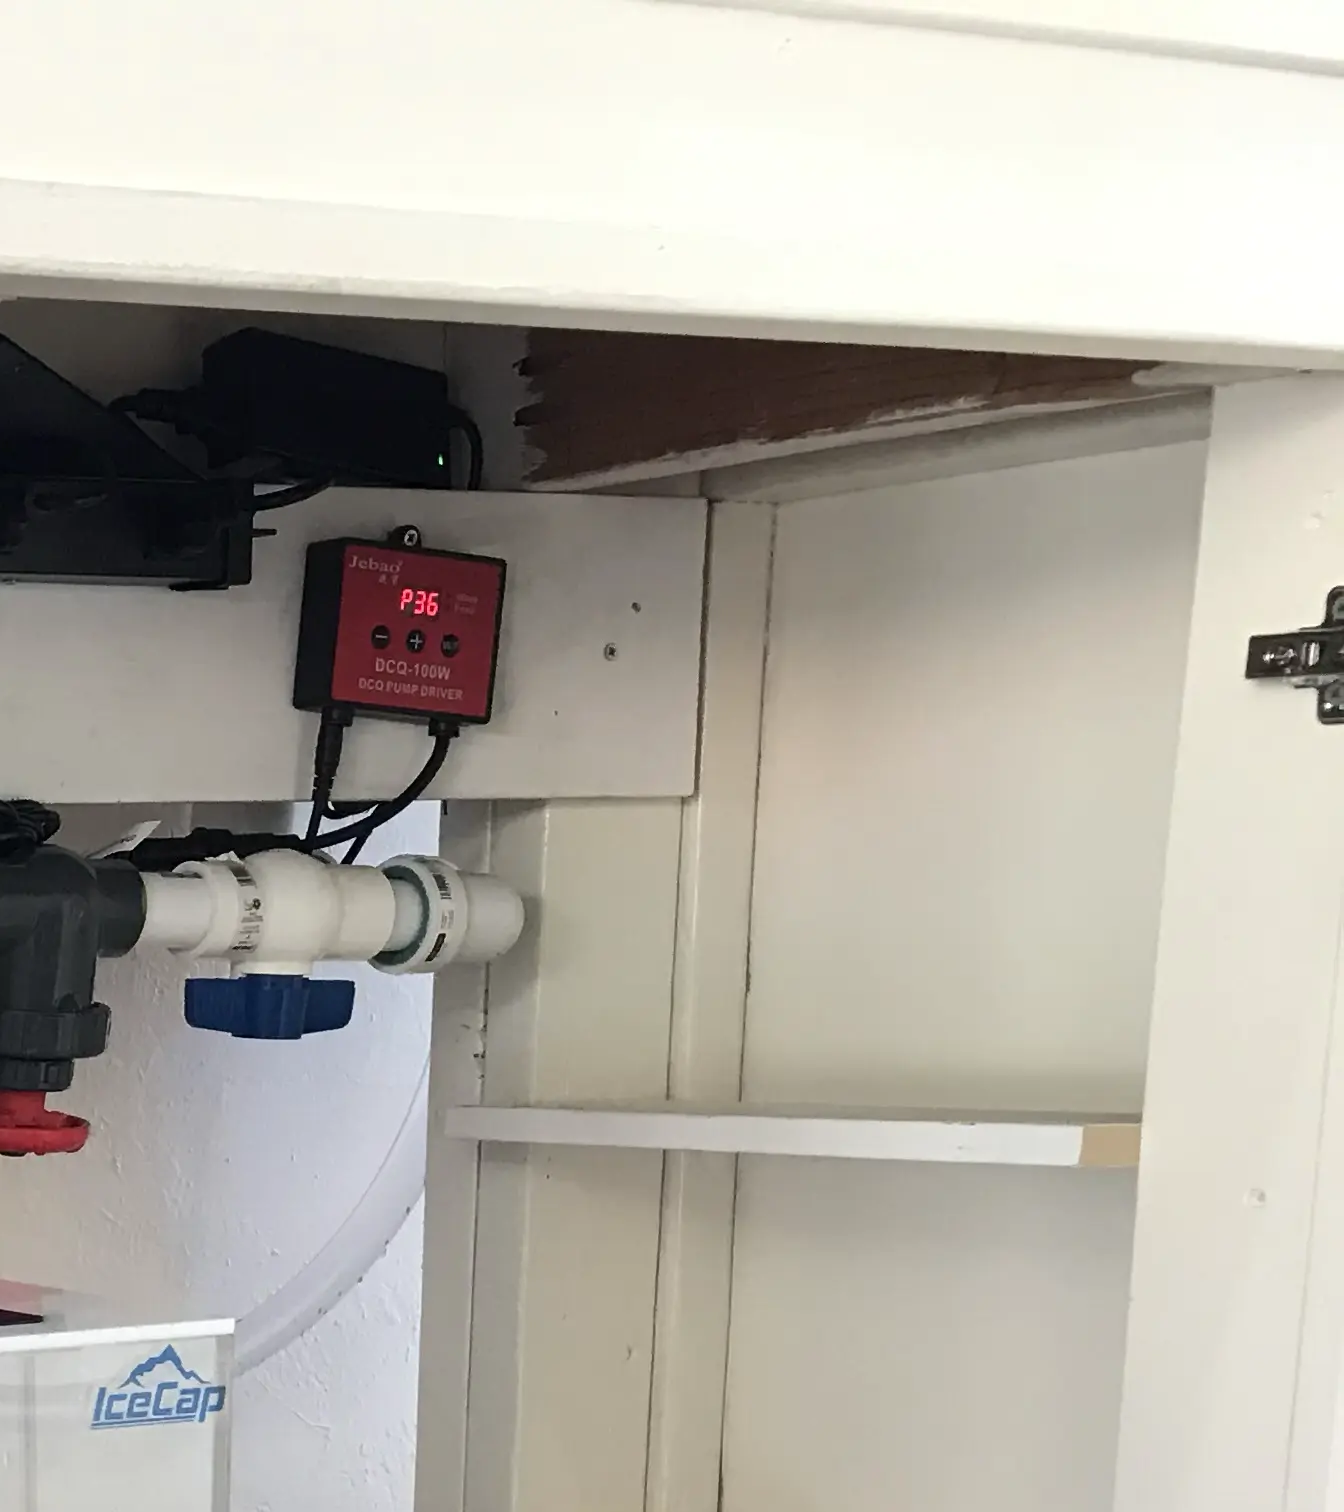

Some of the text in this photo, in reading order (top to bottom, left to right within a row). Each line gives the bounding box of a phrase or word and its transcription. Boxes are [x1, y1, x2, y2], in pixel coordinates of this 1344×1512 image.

[348, 554, 401, 574] Jebao
[400, 588, 439, 617] P36
[374, 657, 452, 681] DCQ-100W
[358, 677, 464, 701] DCQ PUMP DRIVER
[92, 1381, 226, 1424] IceCap
